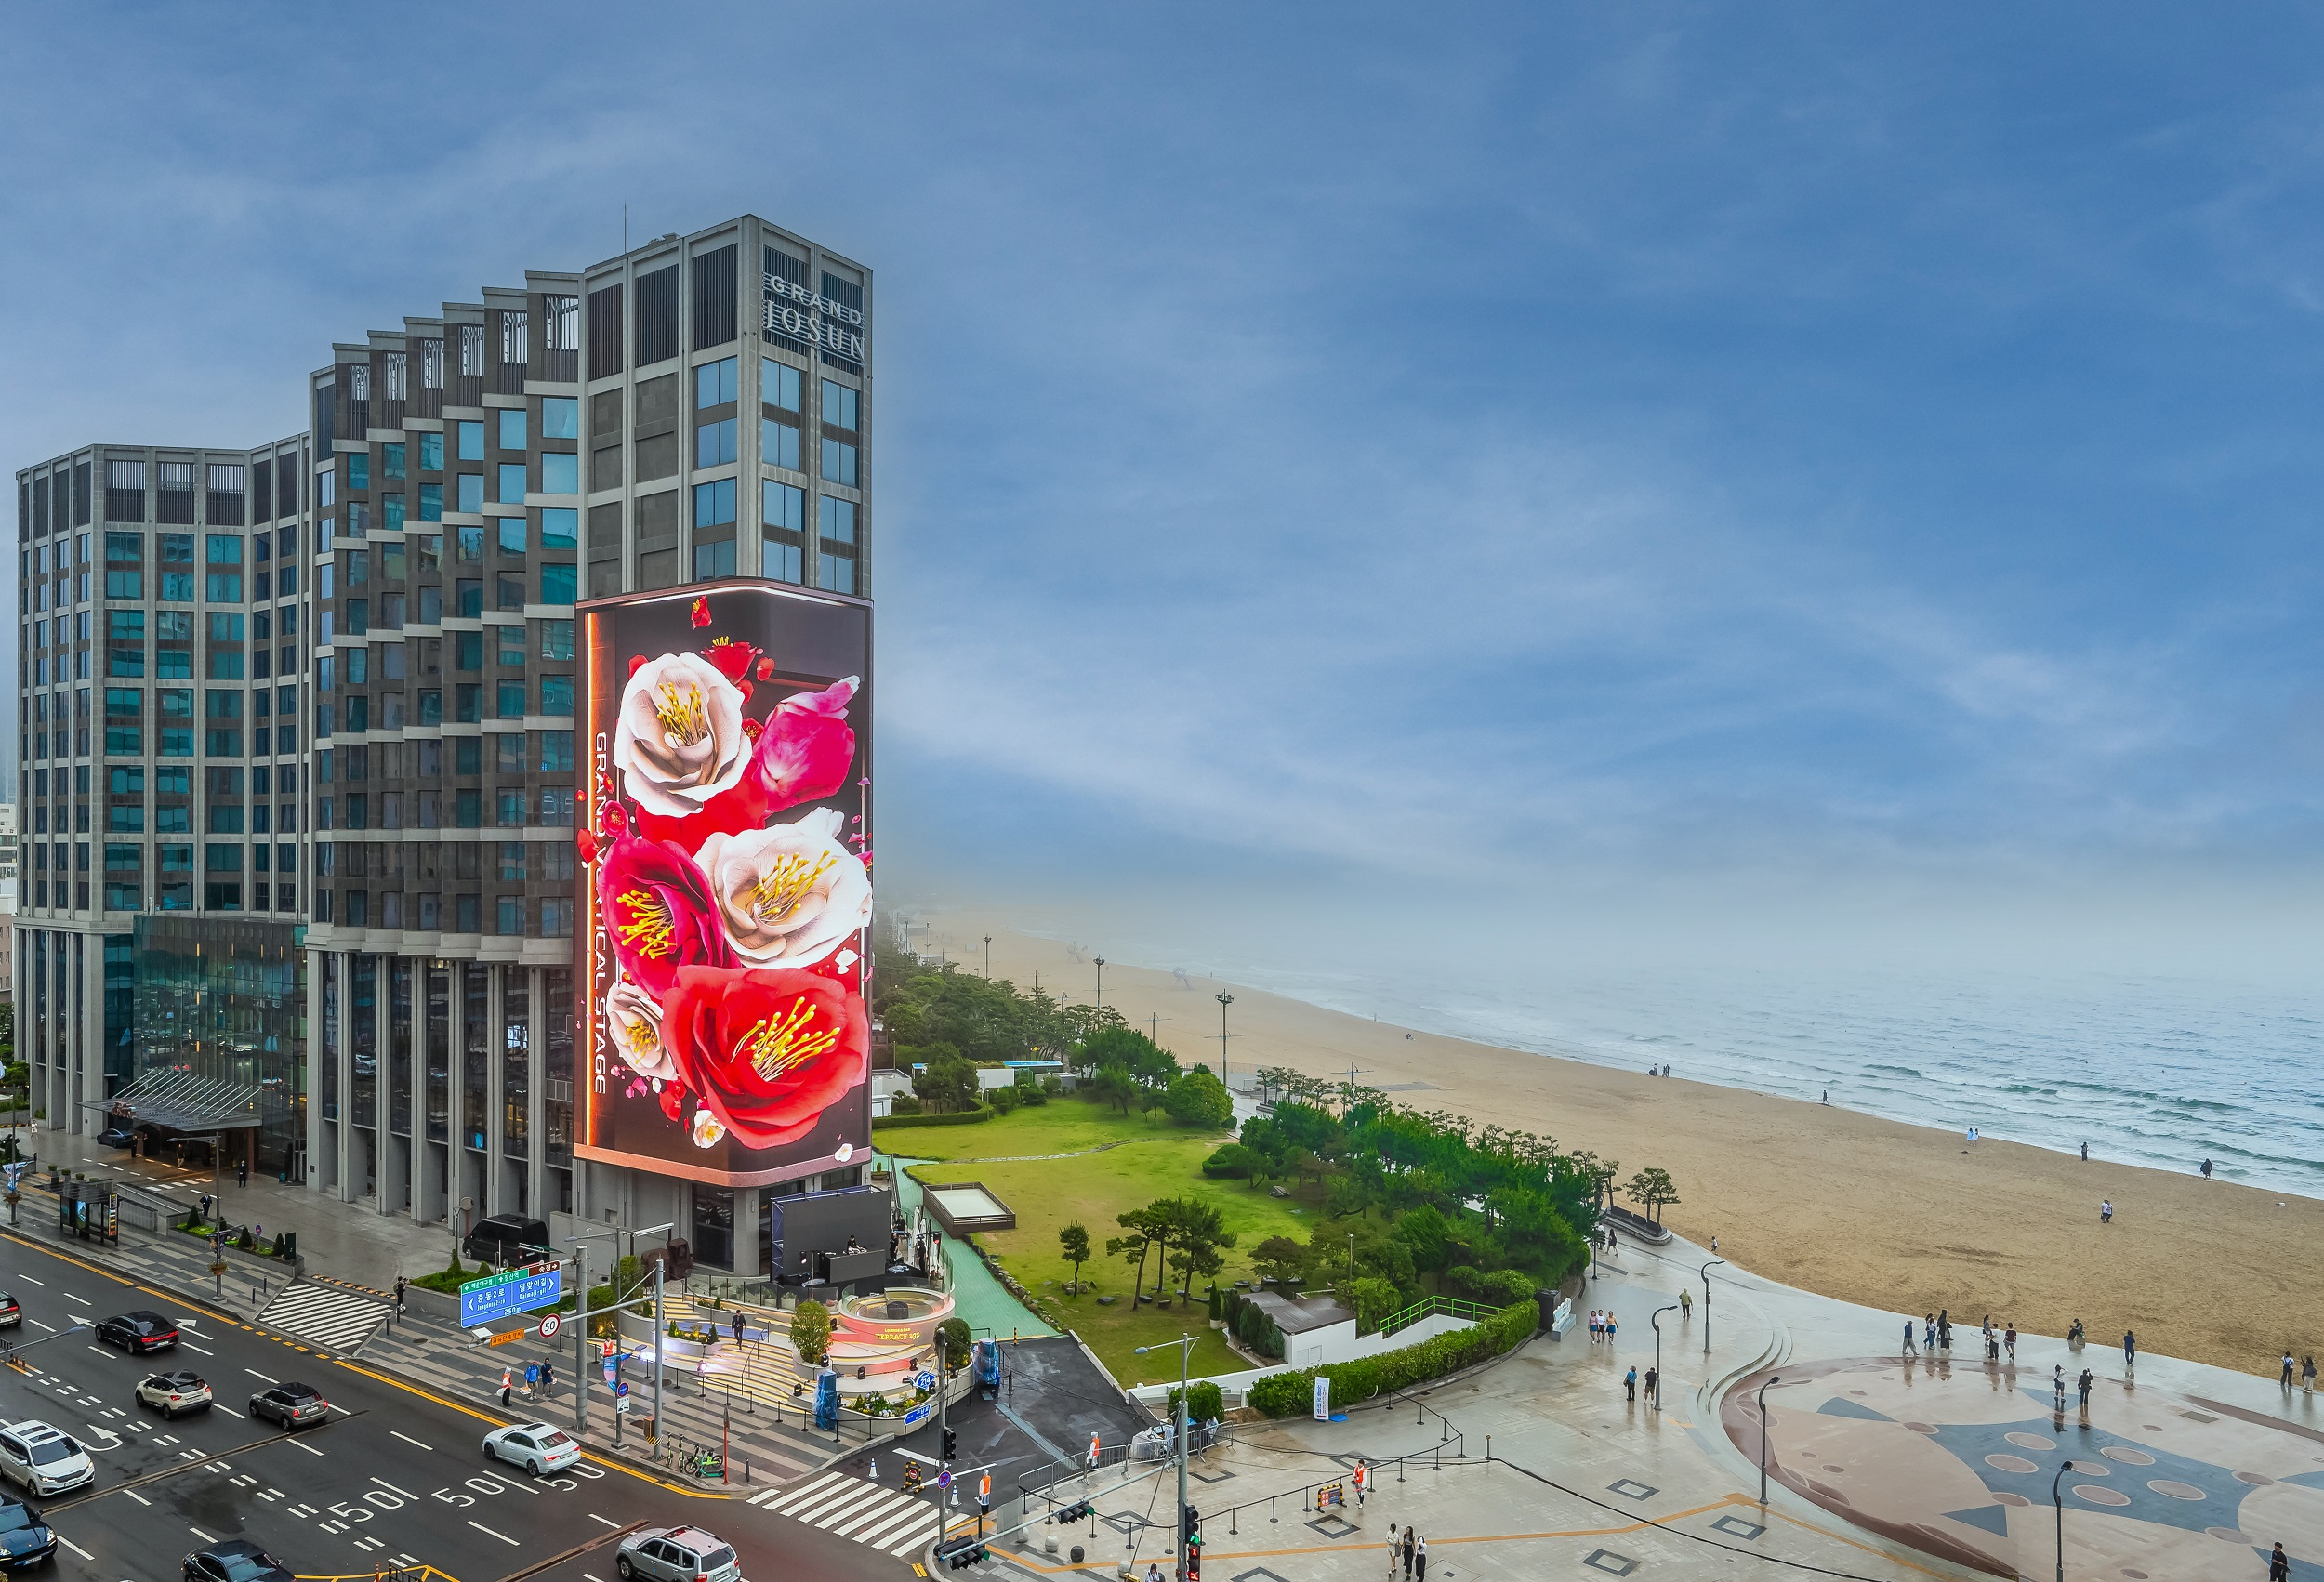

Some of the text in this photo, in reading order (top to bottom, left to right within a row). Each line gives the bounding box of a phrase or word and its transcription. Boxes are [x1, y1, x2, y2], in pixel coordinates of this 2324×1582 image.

[770, 276, 862, 325] GRAND
[762, 300, 865, 363] JOSUN
[595, 732, 607, 837] GRAND
[595, 996, 606, 1094] STAGE
[477, 1288, 505, 1303] 중동2로
[519, 1277, 547, 1292] 달맞이길
[545, 1320, 556, 1332] 50
[920, 1377, 931, 1386] 214
[430, 1477, 506, 1509] 50
[533, 1462, 606, 1492] 50
[326, 1490, 405, 1523] 50
